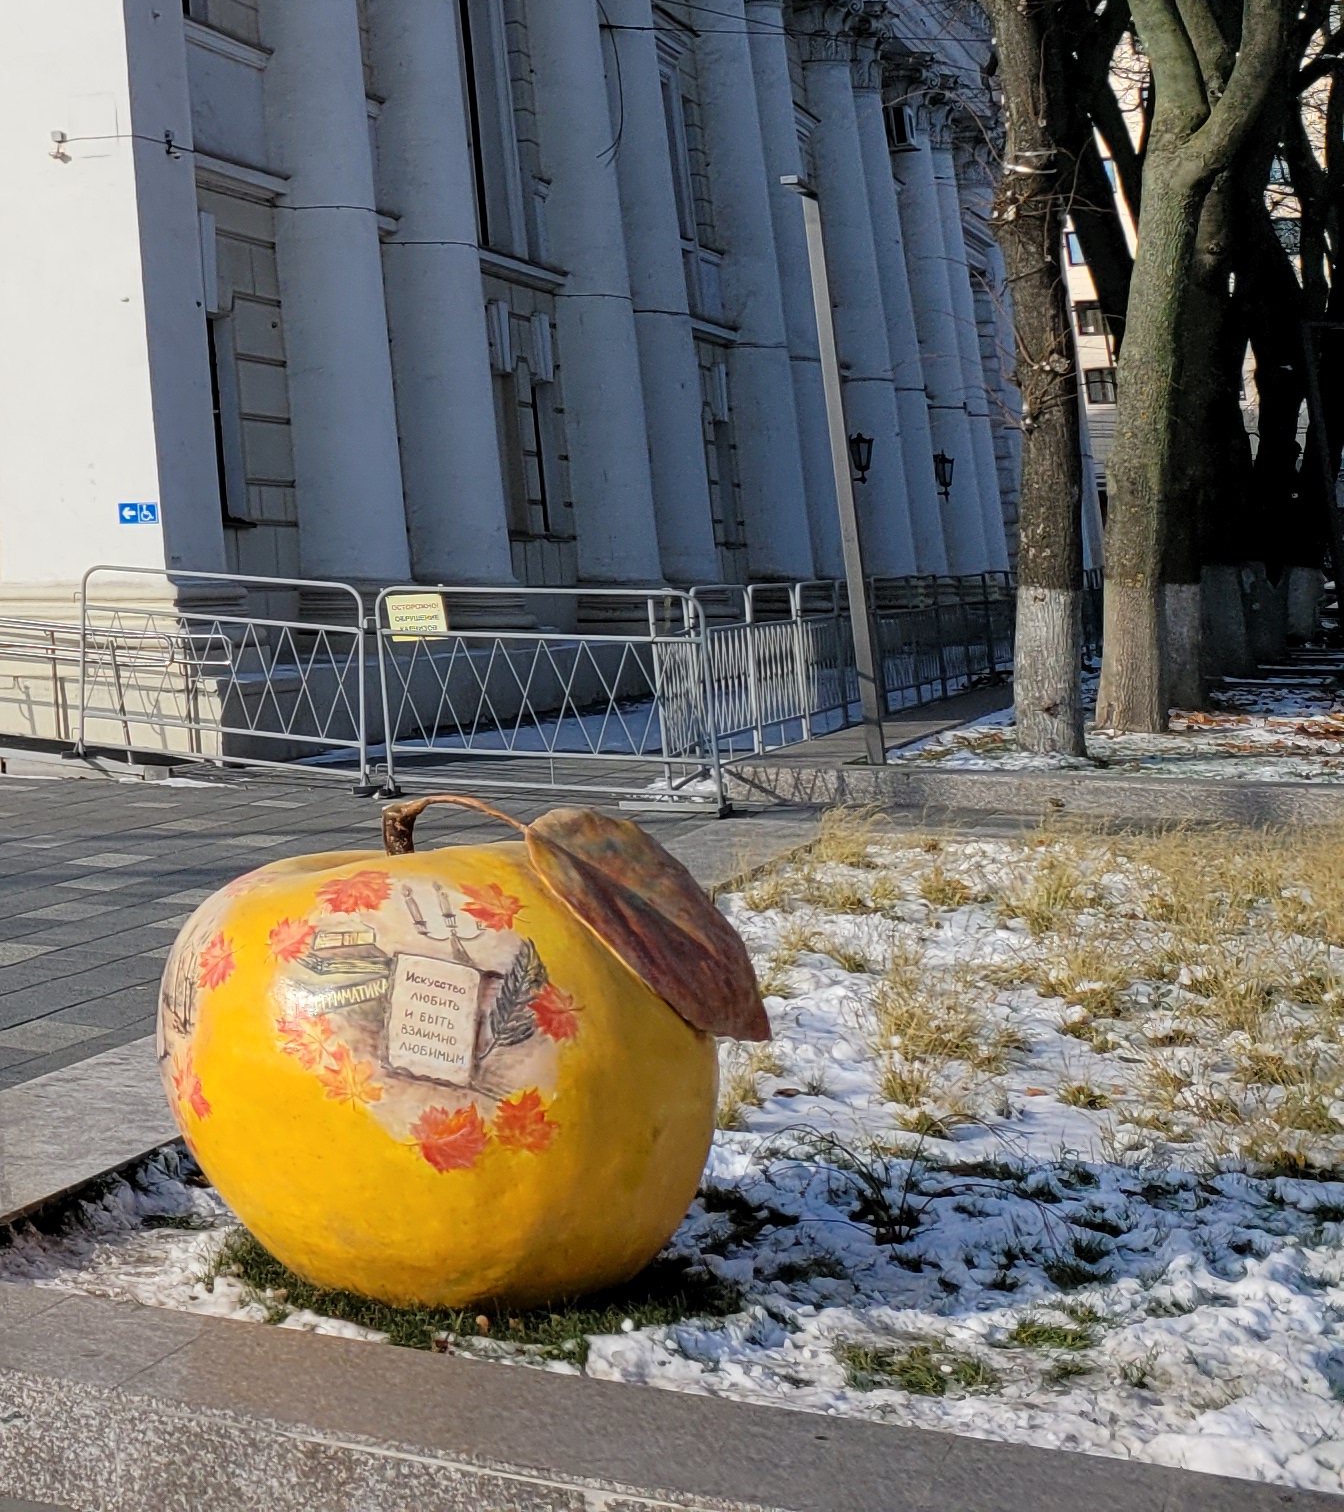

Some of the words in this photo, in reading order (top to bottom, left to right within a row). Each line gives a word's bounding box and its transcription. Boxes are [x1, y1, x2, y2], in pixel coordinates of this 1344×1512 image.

[410, 992, 460, 1011] ЛЮБИТЬ
[419, 1012, 455, 1030] БЫТЬ
[401, 1023, 457, 1046] ВЗАИМНО
[399, 1041, 465, 1065] ЛЮБИМЫМ
